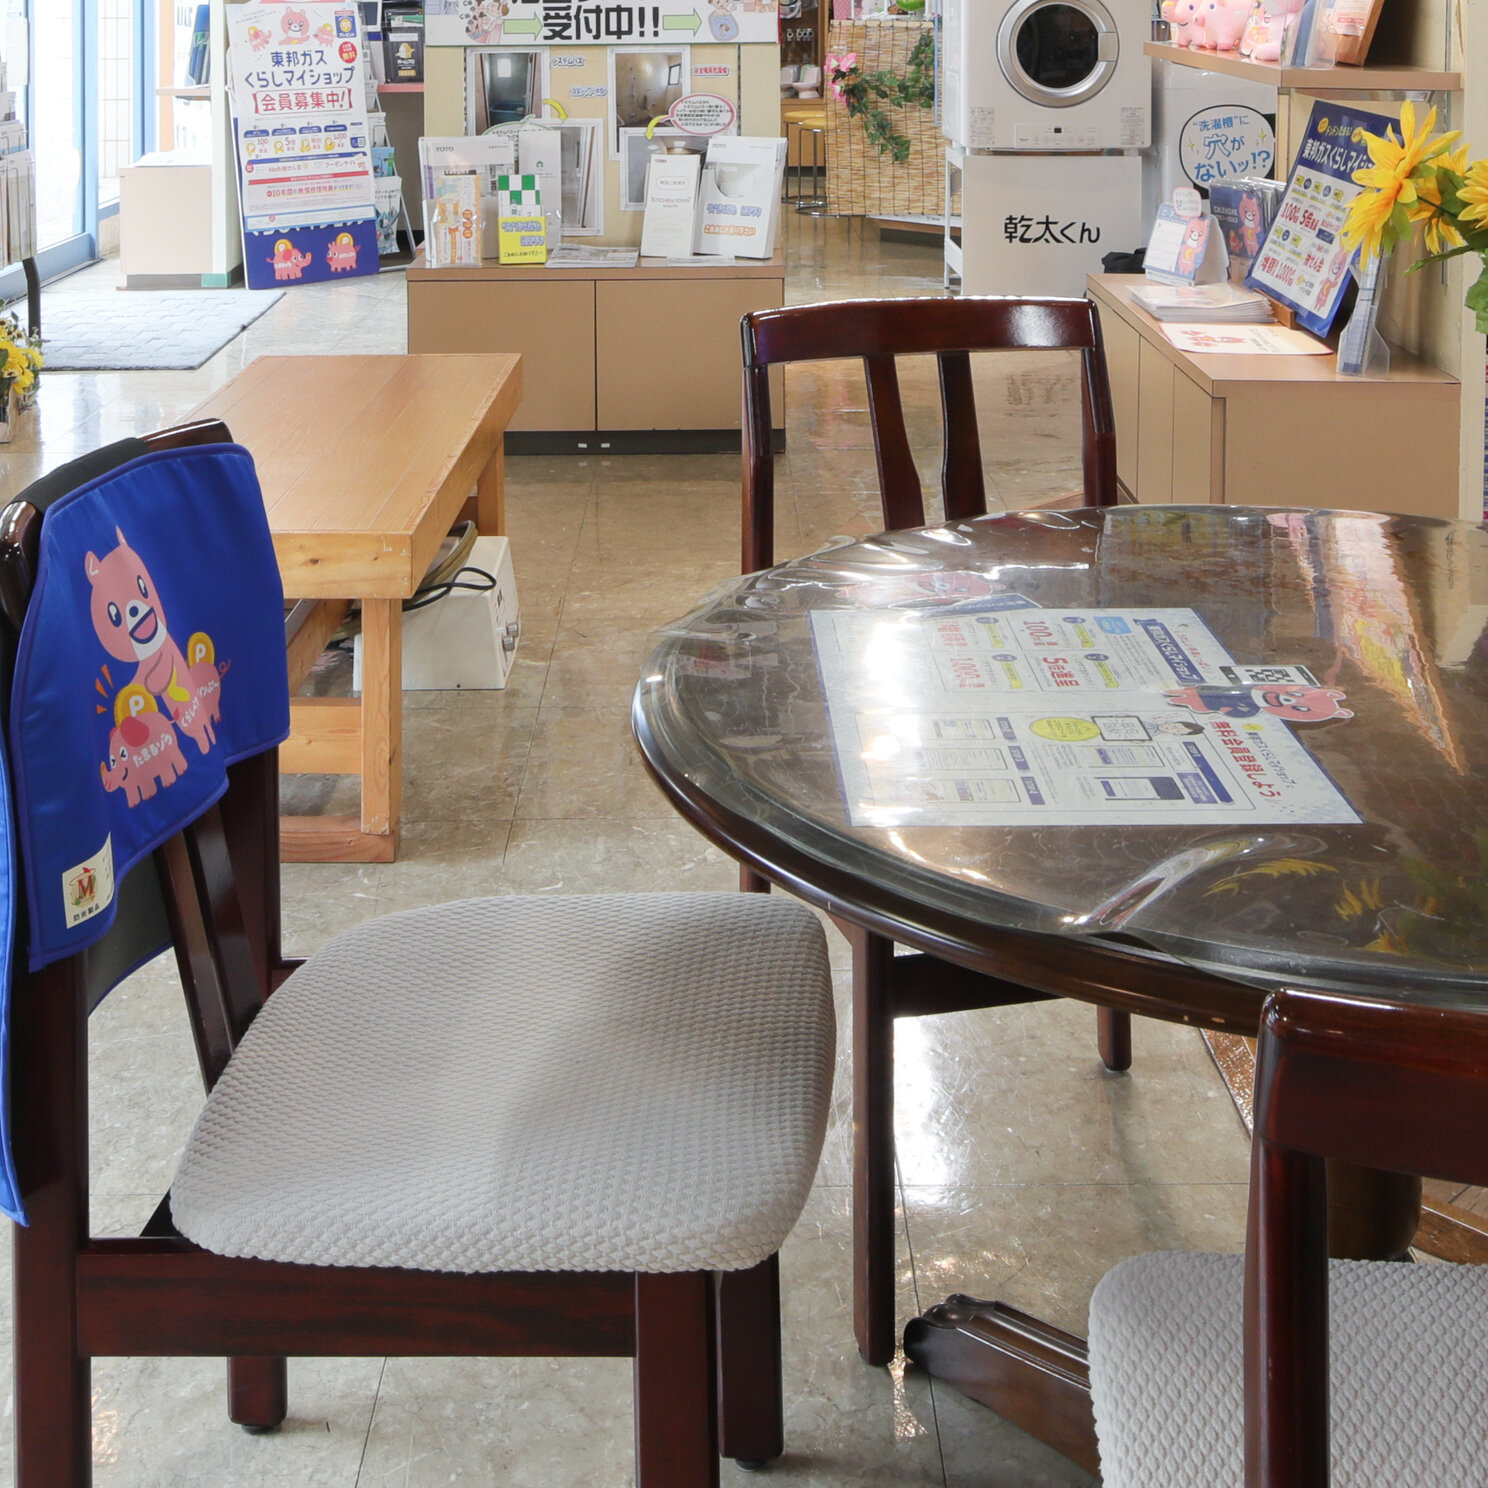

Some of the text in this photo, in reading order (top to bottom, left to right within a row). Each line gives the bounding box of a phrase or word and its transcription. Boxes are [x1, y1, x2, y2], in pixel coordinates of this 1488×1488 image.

[270, 49, 327, 68] 東邦ガス
[244, 66, 355, 88] くらしマイショップ
[1202, 133, 1245, 161] 穴が
[1004, 214, 1101, 244] 乾太くん
[132, 733, 174, 769] たまるゾウ
